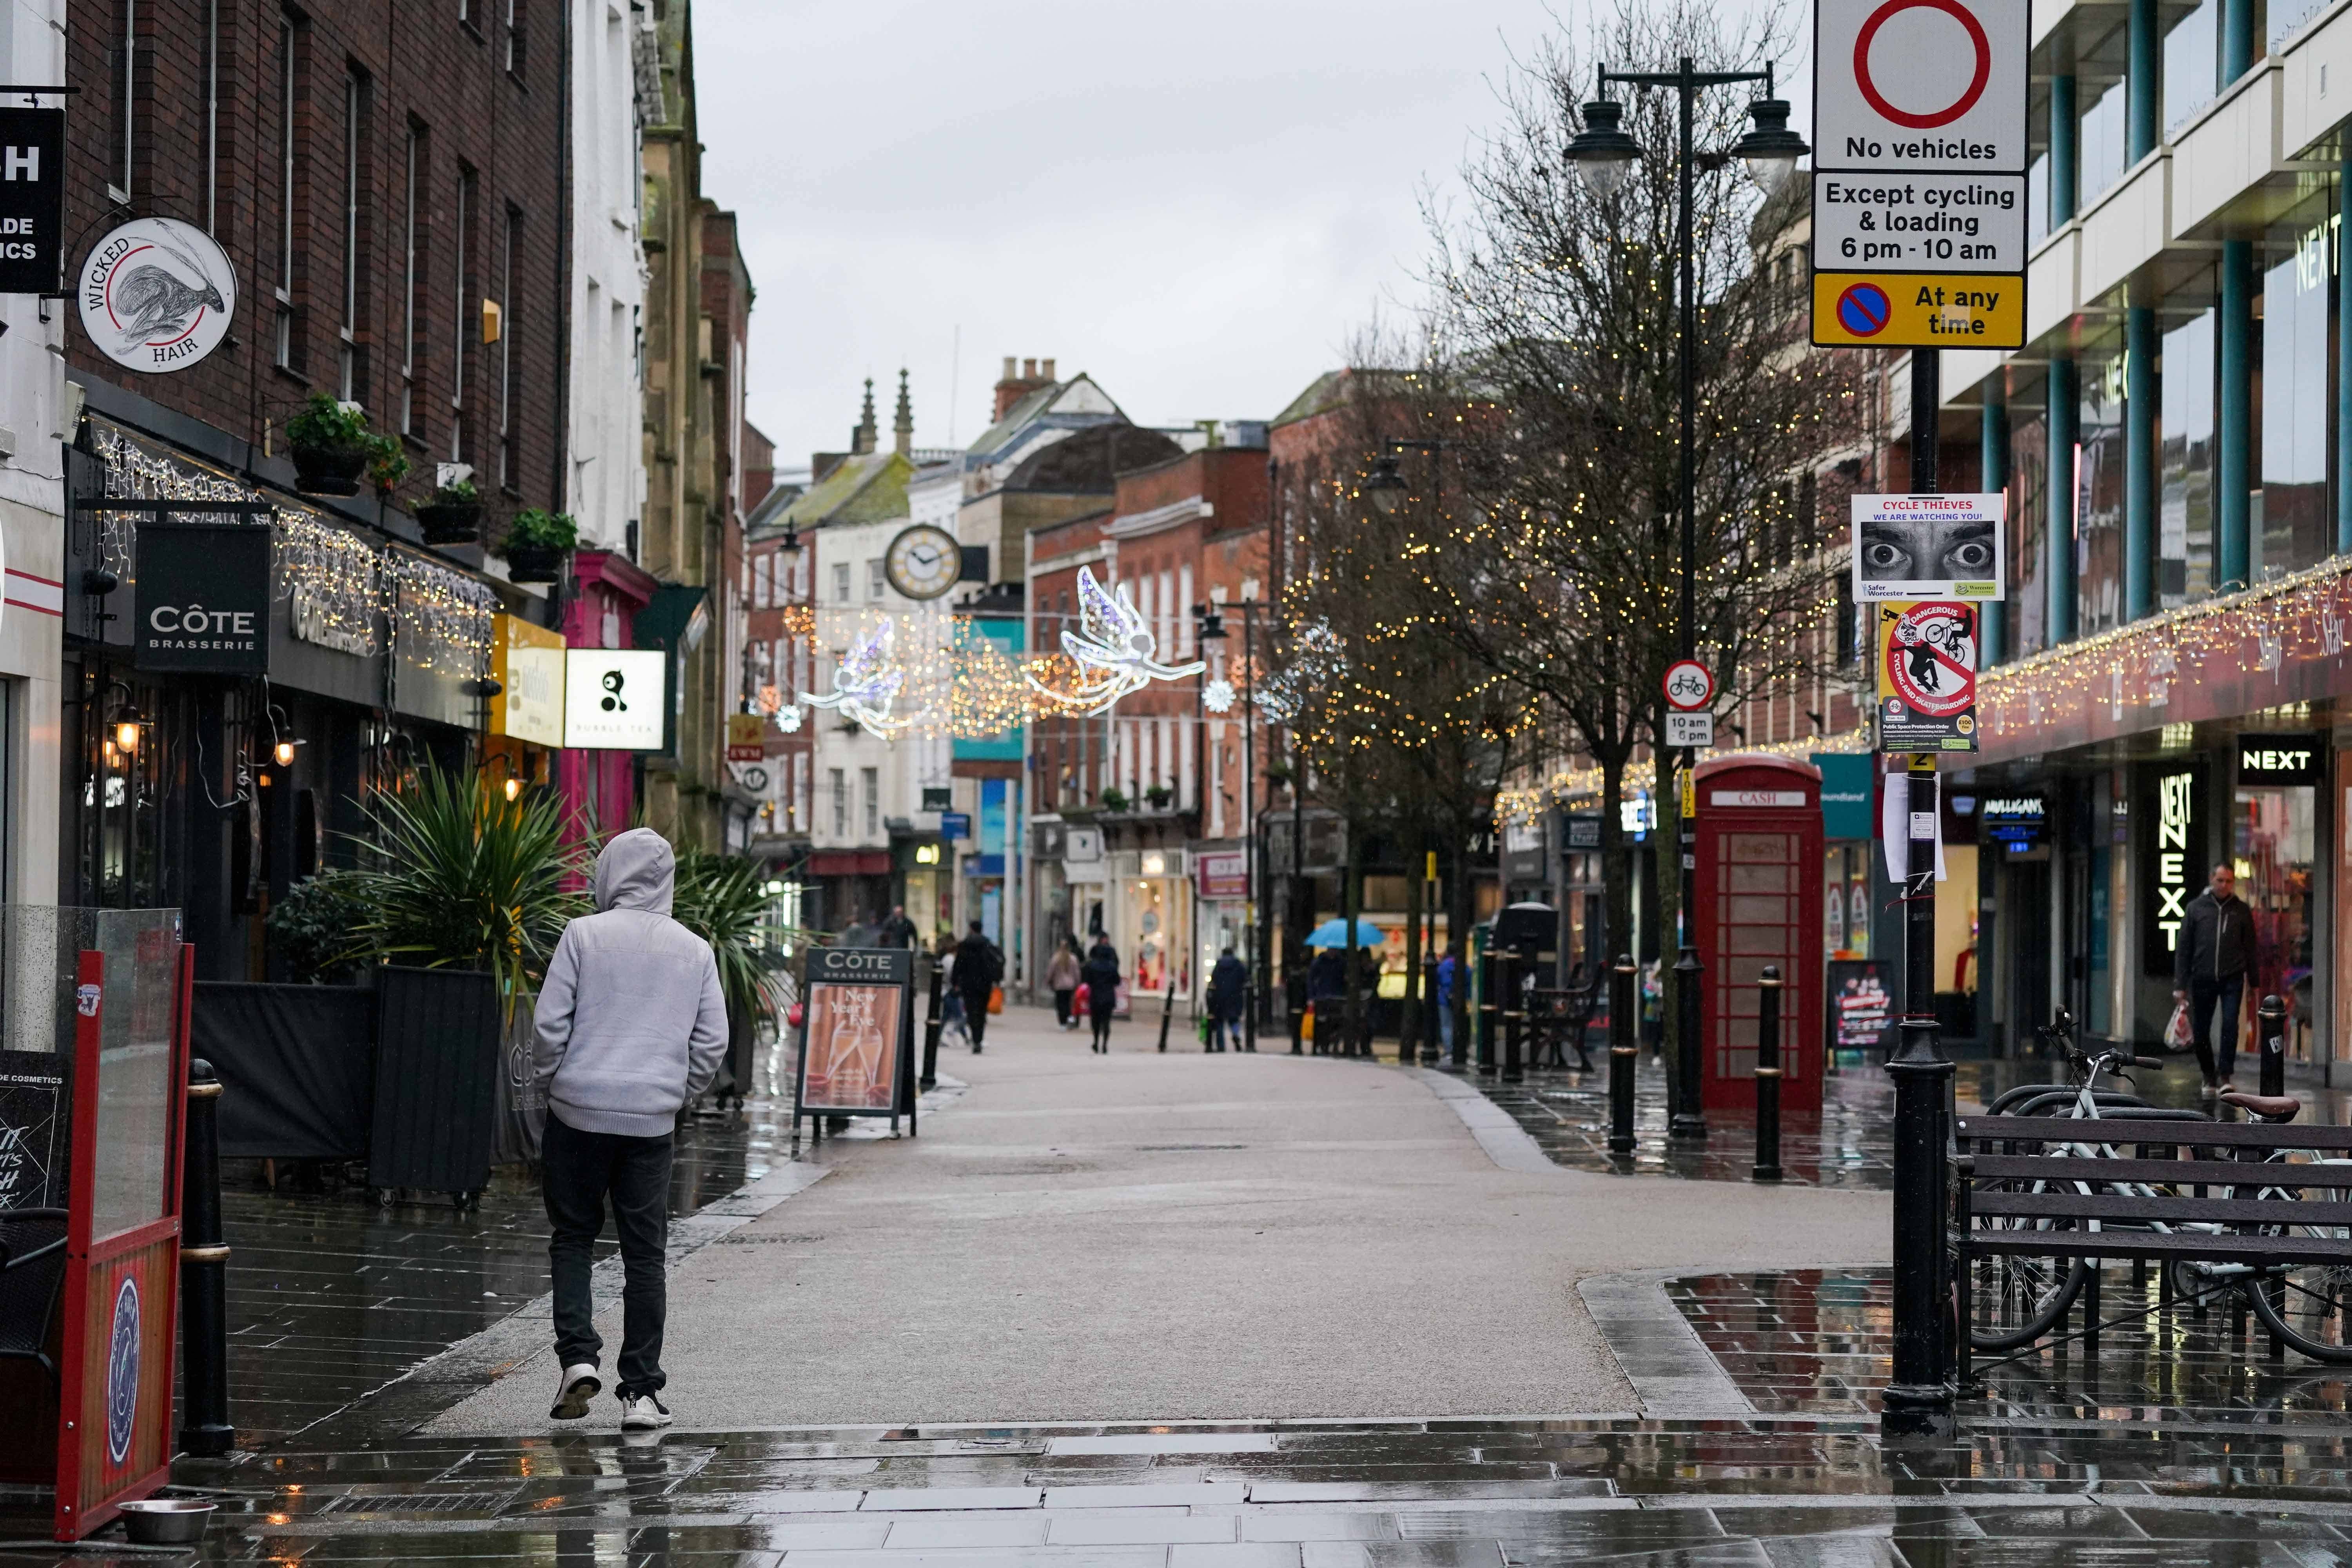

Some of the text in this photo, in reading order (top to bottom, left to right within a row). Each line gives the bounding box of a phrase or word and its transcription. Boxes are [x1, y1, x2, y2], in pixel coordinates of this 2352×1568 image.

[1846, 137, 1996, 160] No vehicles
[0, 146, 39, 181] H
[1826, 183, 2014, 210] Except cycling
[0, 218, 33, 234] DE
[1859, 212, 1979, 236] & loading
[1924, 238, 1952, 260] 10
[1960, 243, 1997, 260] am
[2296, 213, 2341, 297] NEXT
[89, 238, 129, 311] WICKED
[1916, 287, 2000, 312] At any
[1929, 313, 1985, 335] time
[153, 338, 198, 362] HAIR
[1883, 501, 1973, 510] CYCLE THIEVES
[150, 604, 254, 635] CÔTE
[1910, 606, 1958, 624] DANGEROUS
[149, 639, 254, 650] BRASSERIE
[1894, 653, 1970, 710] CYCLING AND SKATEBOARDING
[1672, 717, 1706, 728] 10 am
[1679, 730, 1685, 740] 6
[1689, 732, 1708, 742] pm
[2243, 750, 2311, 769] NEXT
[1739, 792, 1776, 804] CASH
[2160, 773, 2192, 826] NEXT
[2158, 823, 2186, 951] NEXT
[825, 951, 892, 969] CÔTE
[846, 990, 877, 1002] New
[831, 1001, 871, 1014] Year's
[849, 1014, 875, 1026] Eve
[11, 1075, 63, 1084] COSMETICS
